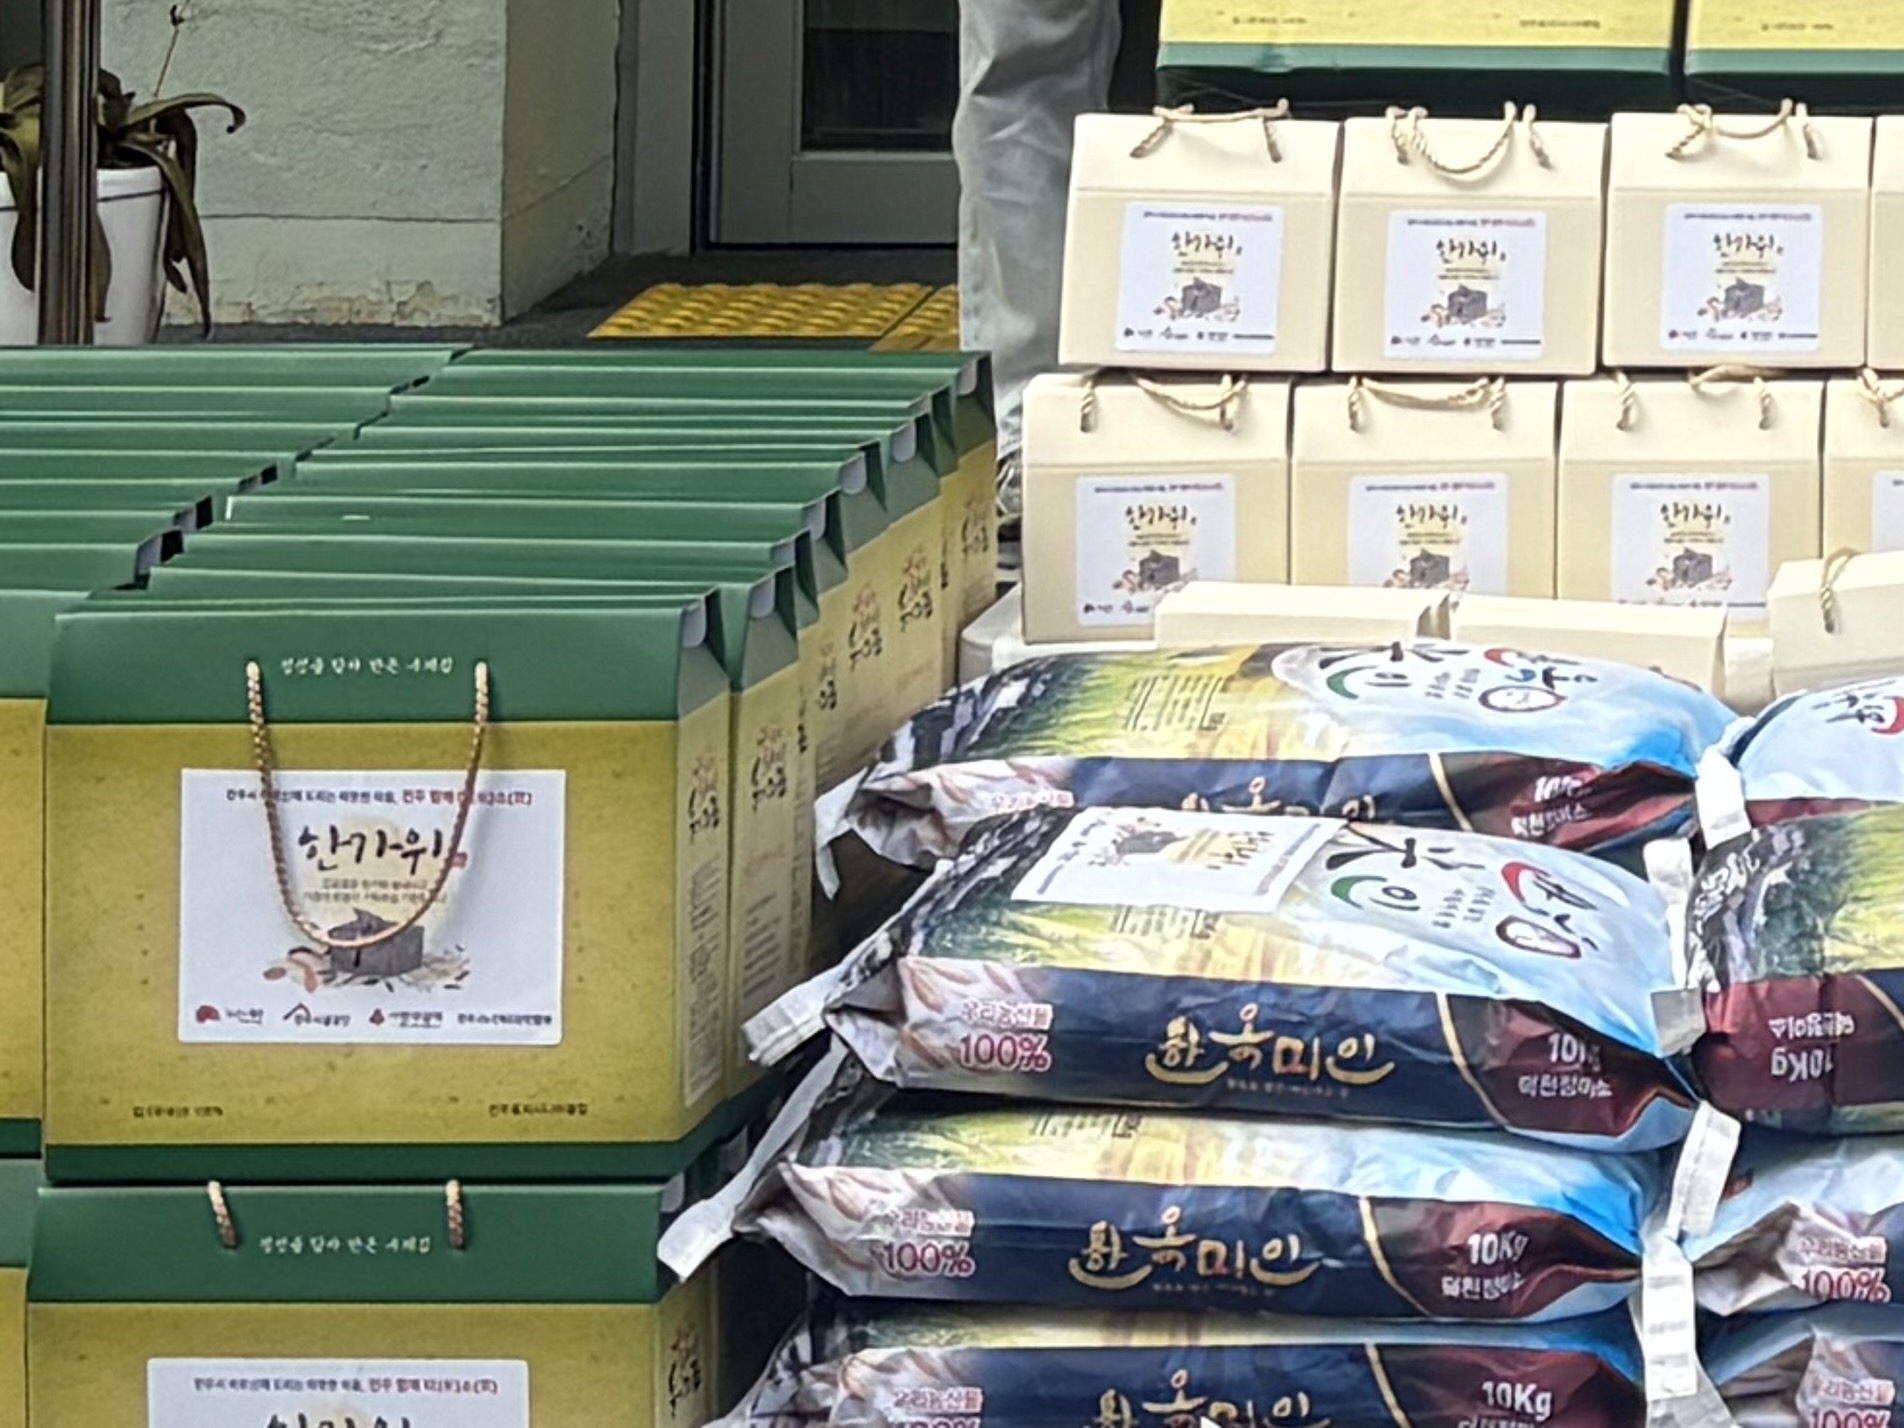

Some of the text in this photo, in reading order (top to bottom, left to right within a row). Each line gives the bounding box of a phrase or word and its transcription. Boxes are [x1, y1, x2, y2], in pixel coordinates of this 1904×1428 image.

[1171, 231, 1235, 258] 한가위
[1436, 238, 1500, 264] 한가위
[1713, 233, 1776, 259] 한가위
[1125, 503, 1189, 529] 한가위
[1395, 502, 1458, 529] 한가위
[1660, 500, 1723, 528] 한가위
[297, 823, 446, 875] 한가위
[961, 1032, 1053, 1071] 100%
[1771, 1047, 1835, 1082] 10Kg
[883, 1240, 976, 1278] 100%
[1468, 1230, 1529, 1264] 10Kg
[1801, 1267, 1891, 1303] 100%
[1482, 1382, 1551, 1420] 10Kg
